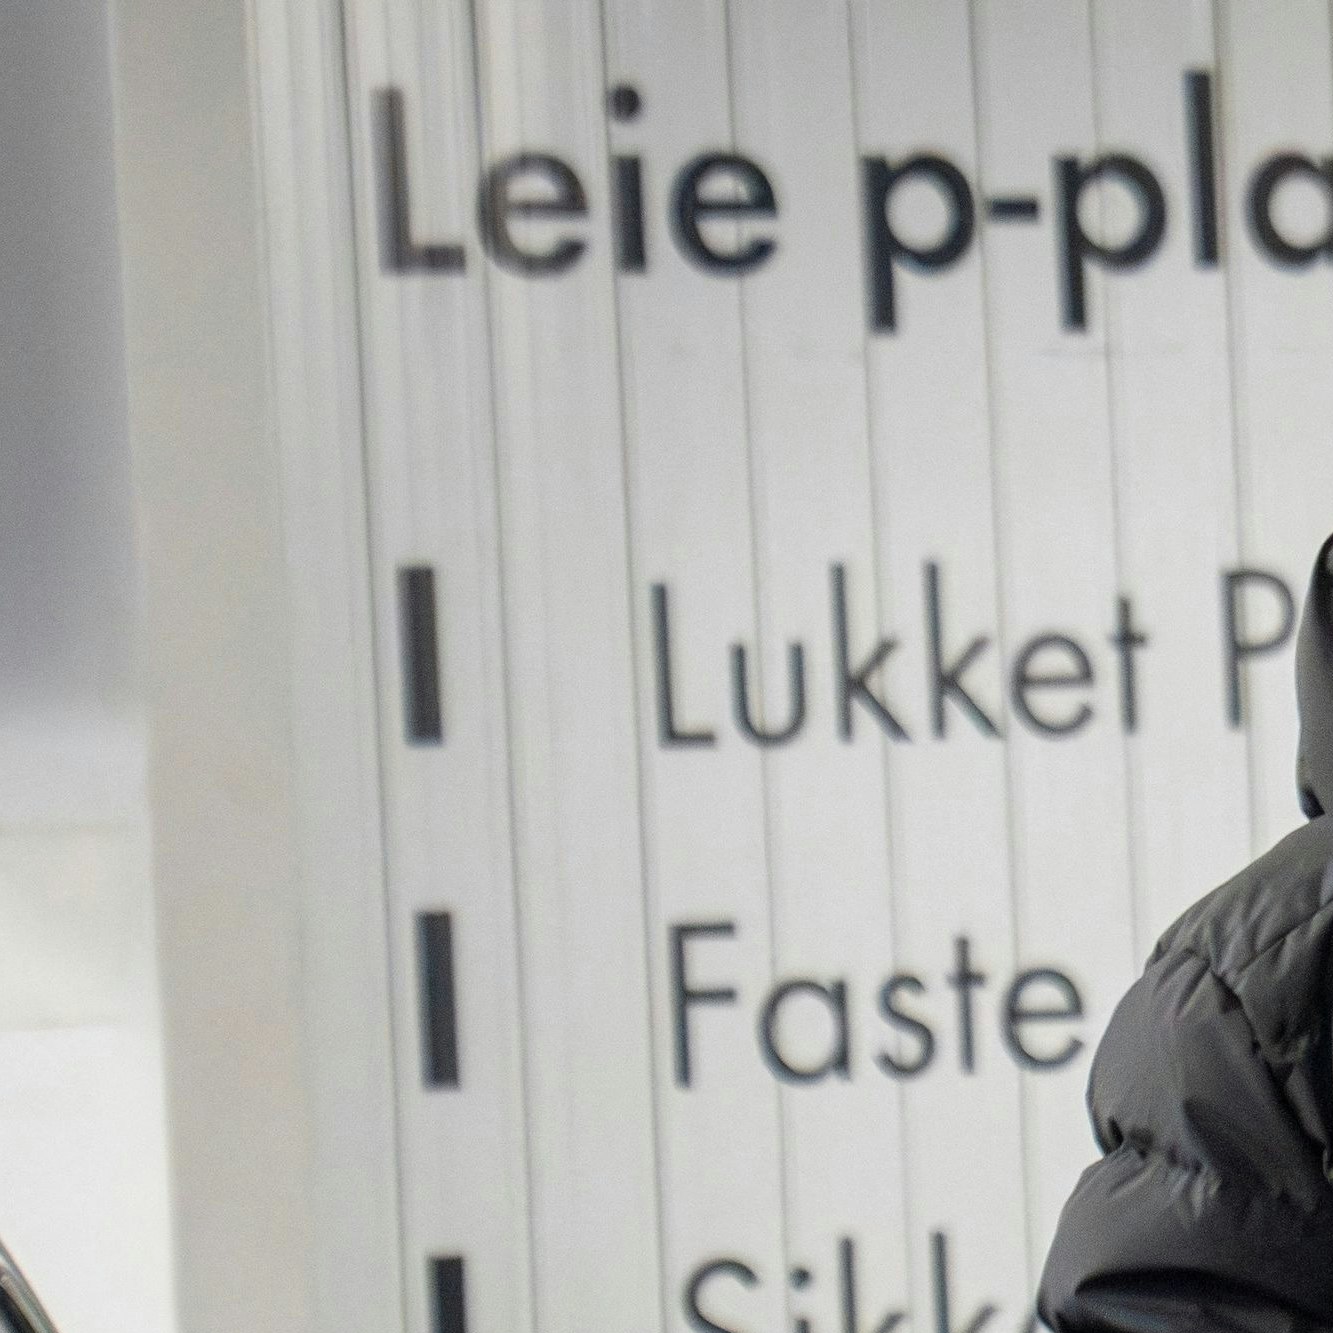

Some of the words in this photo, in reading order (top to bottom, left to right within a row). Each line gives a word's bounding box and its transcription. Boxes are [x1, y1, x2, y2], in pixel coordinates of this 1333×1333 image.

[371, 82, 779, 277] Leie
[650, 560, 1148, 749] Lukket
[668, 920, 1086, 1090] Faste
